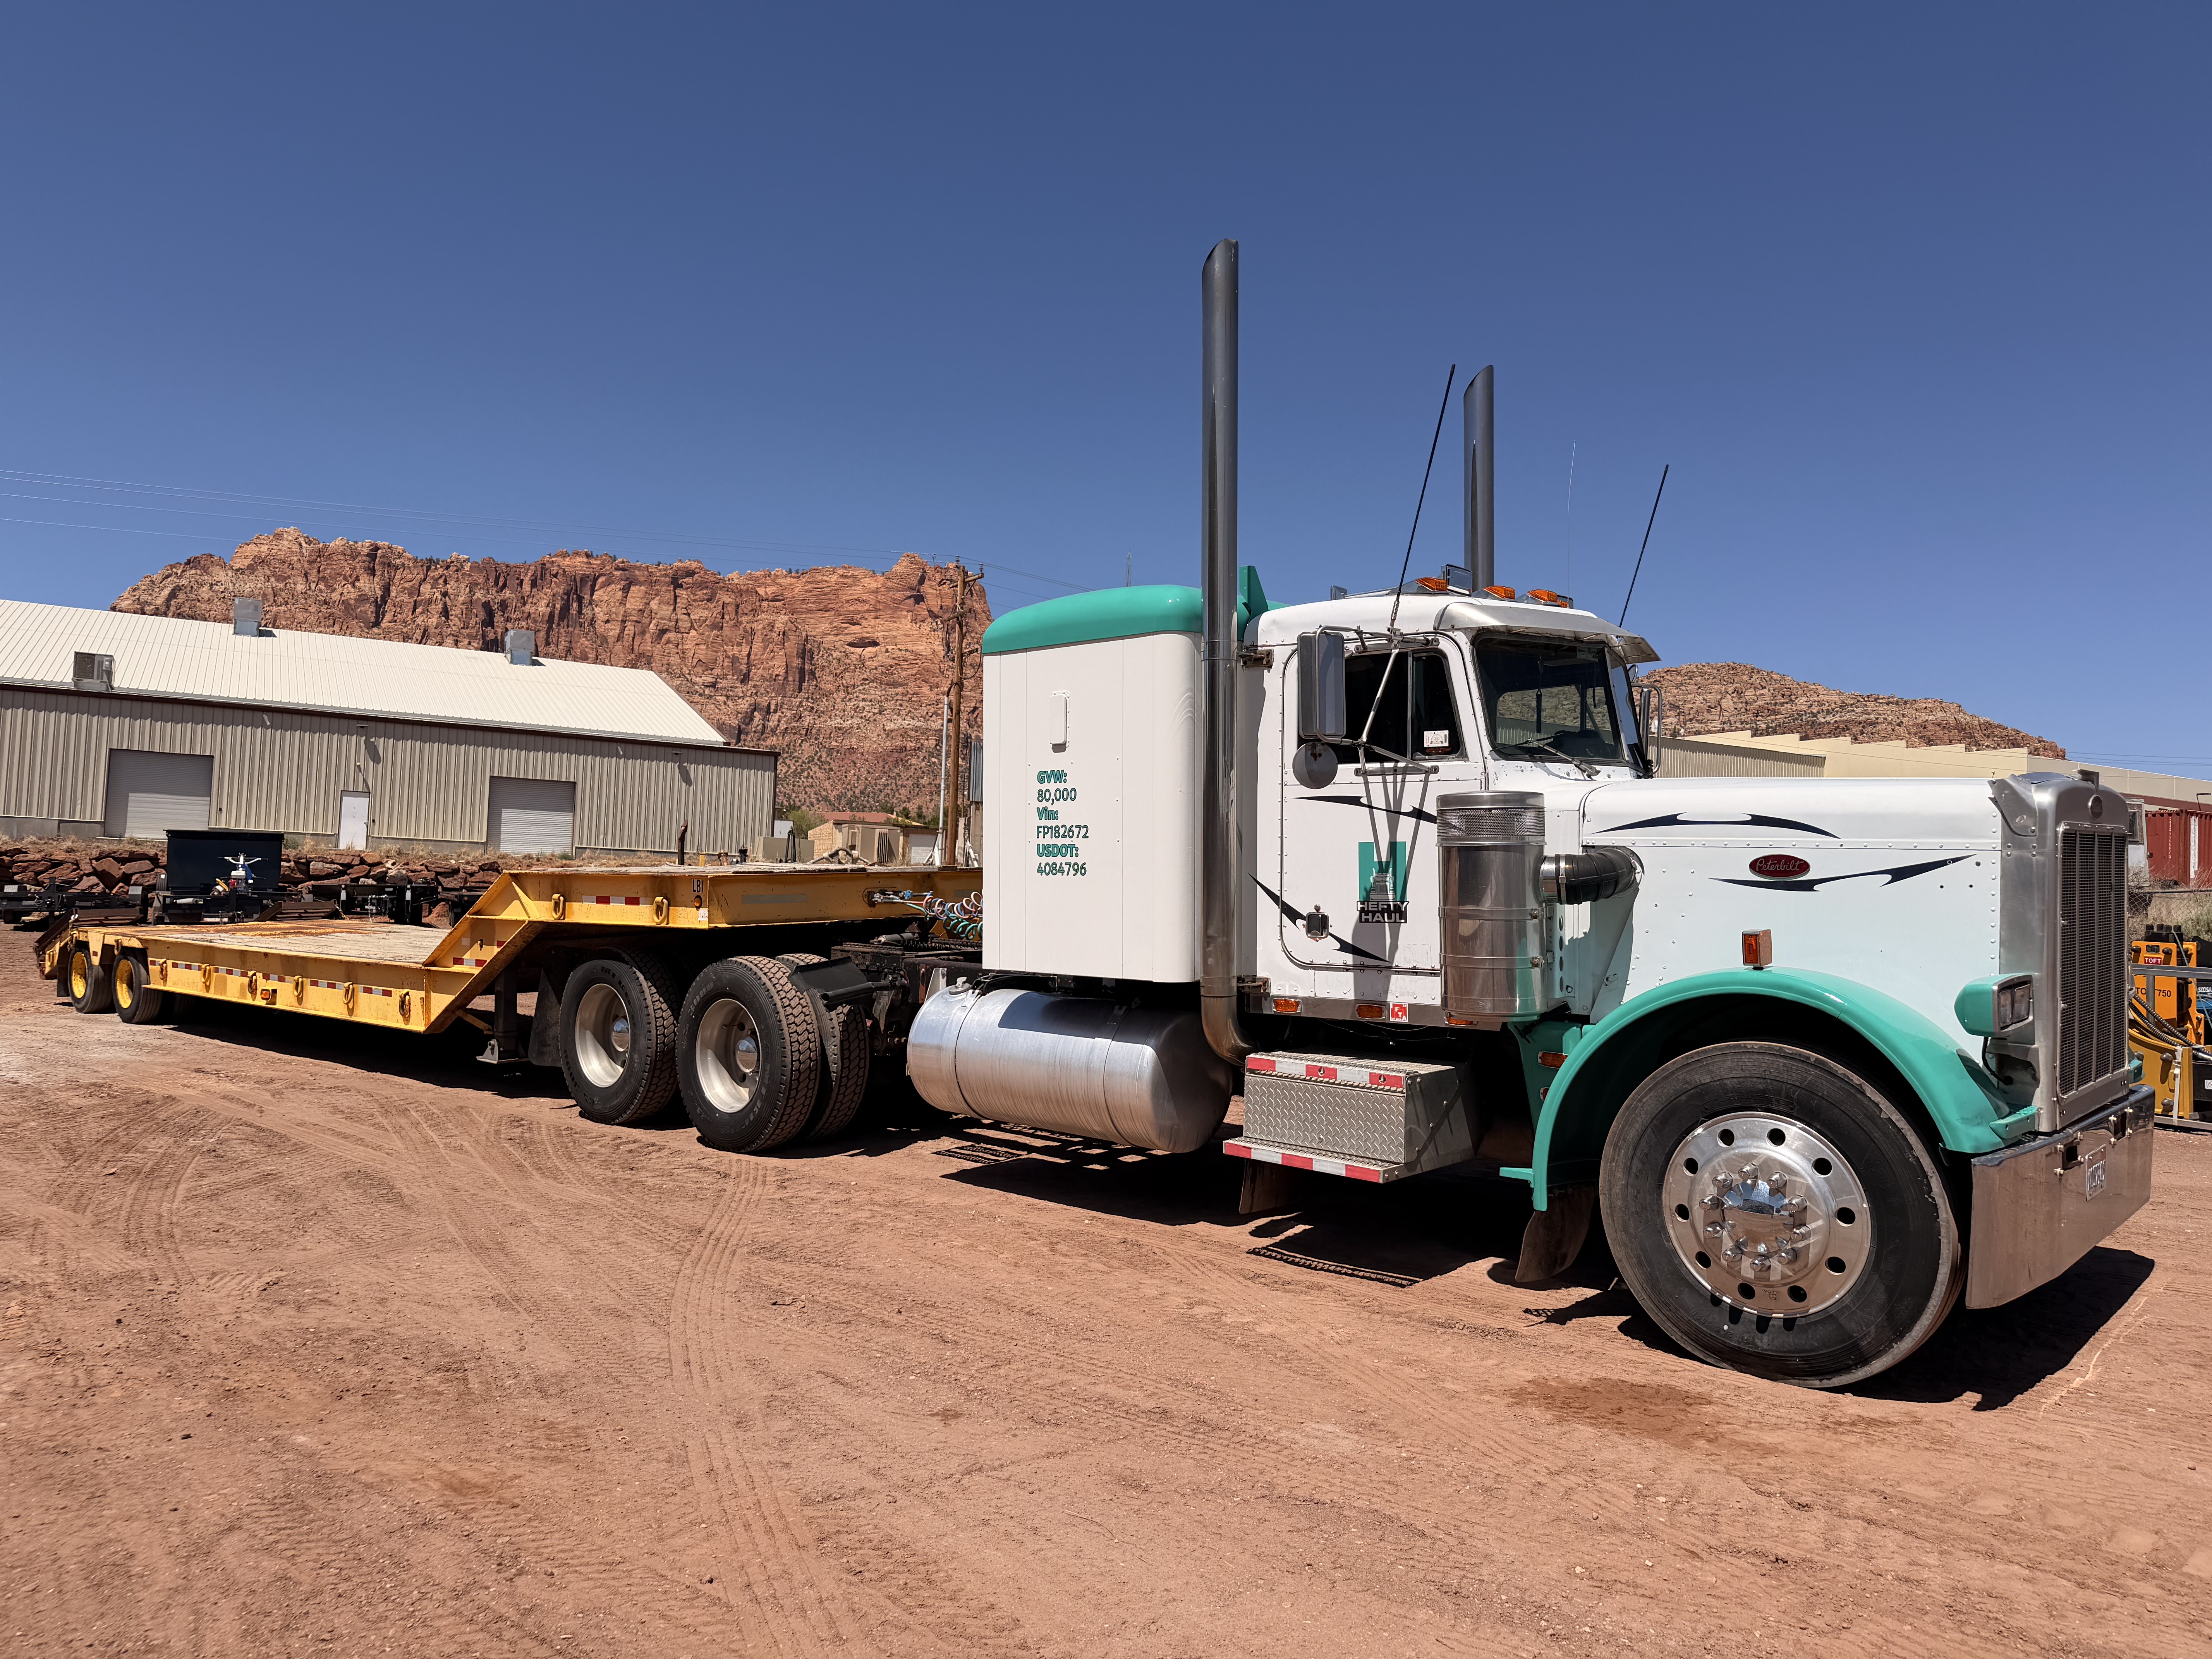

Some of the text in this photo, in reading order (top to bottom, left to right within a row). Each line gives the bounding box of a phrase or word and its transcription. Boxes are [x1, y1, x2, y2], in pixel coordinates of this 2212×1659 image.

[1037, 769, 1067, 784] GVW:
[1037, 787, 1077, 805] 80,000
[1036, 806, 1059, 821] Vin:
[1036, 824, 1089, 839] FP182672
[1036, 843, 1079, 857] USDOT:
[1036, 862, 1087, 876] 4084796
[1756, 858, 1804, 871] Peterbilt
[692, 879, 704, 893] LB1
[1358, 901, 1408, 911] HEFTY
[1361, 913, 1405, 922] HAUL
